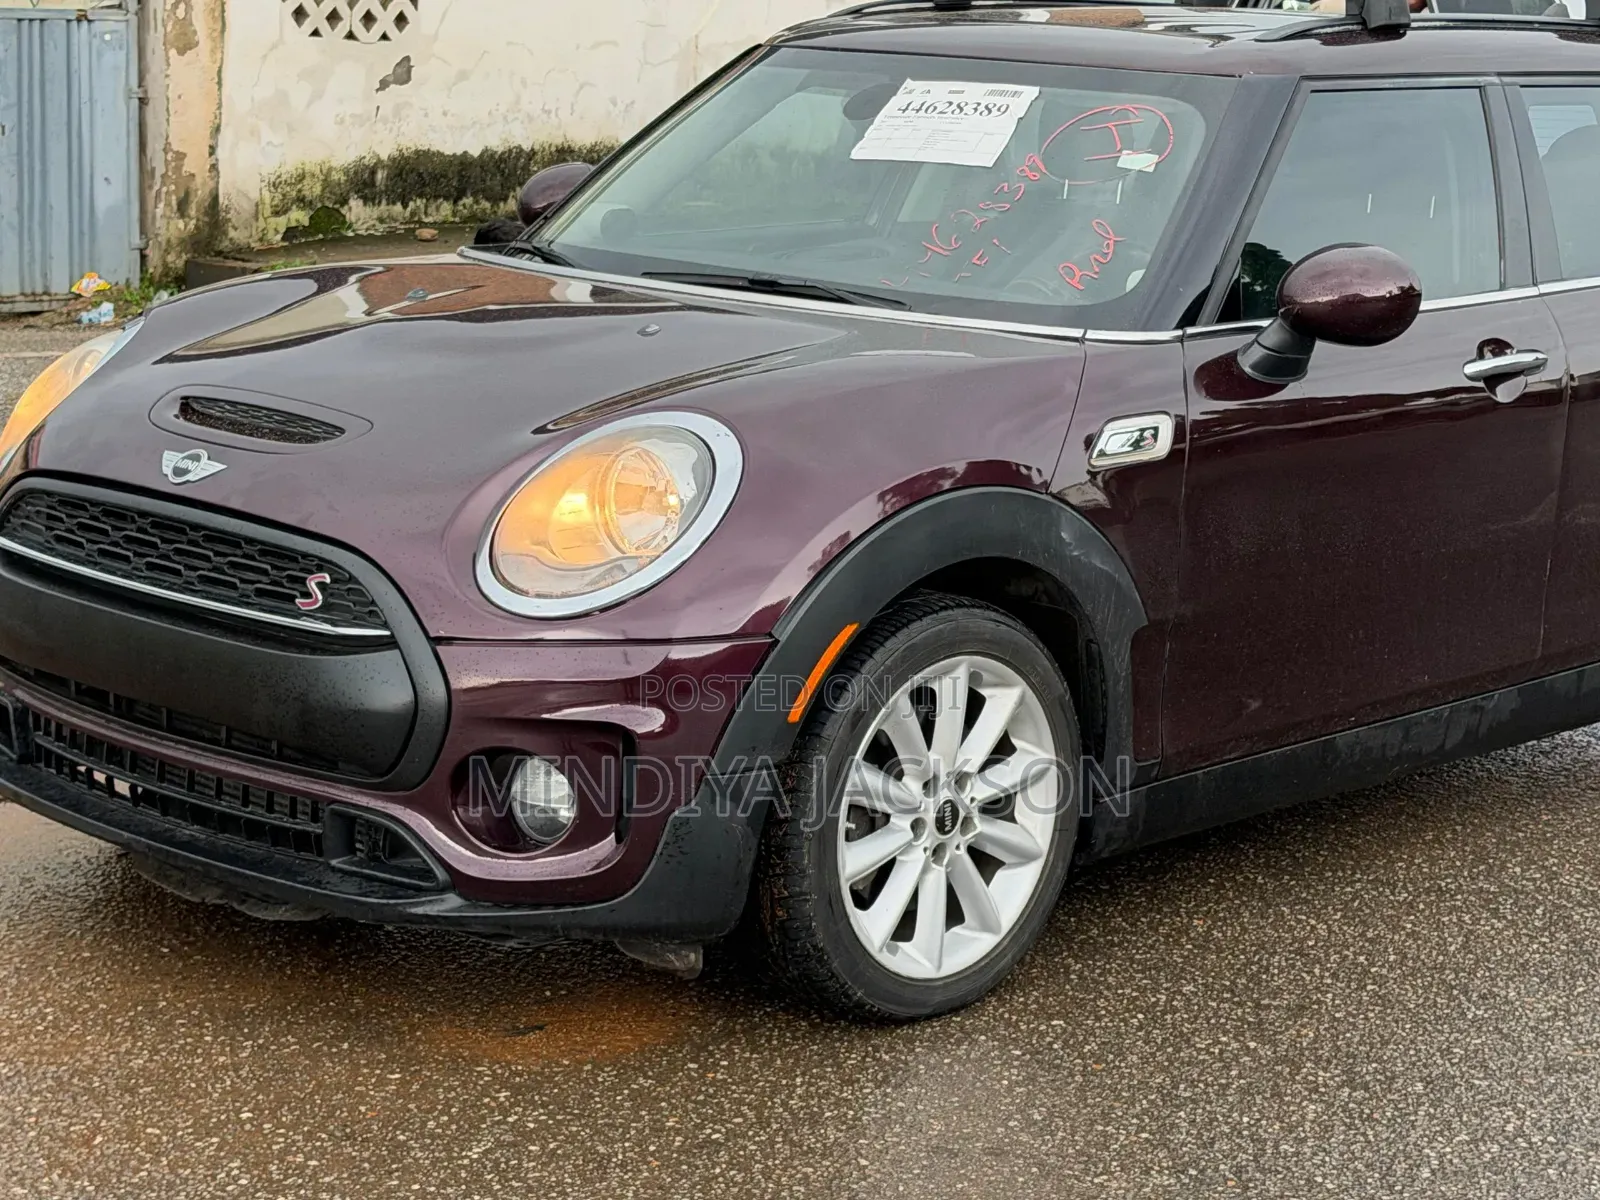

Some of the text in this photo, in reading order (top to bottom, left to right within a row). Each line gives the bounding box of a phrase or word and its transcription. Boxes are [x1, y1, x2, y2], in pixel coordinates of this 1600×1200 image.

[896, 100, 1010, 118] 44628389
[174, 458, 200, 472] MINI
[295, 573, 331, 610] S
[943, 802, 953, 832] MINI
